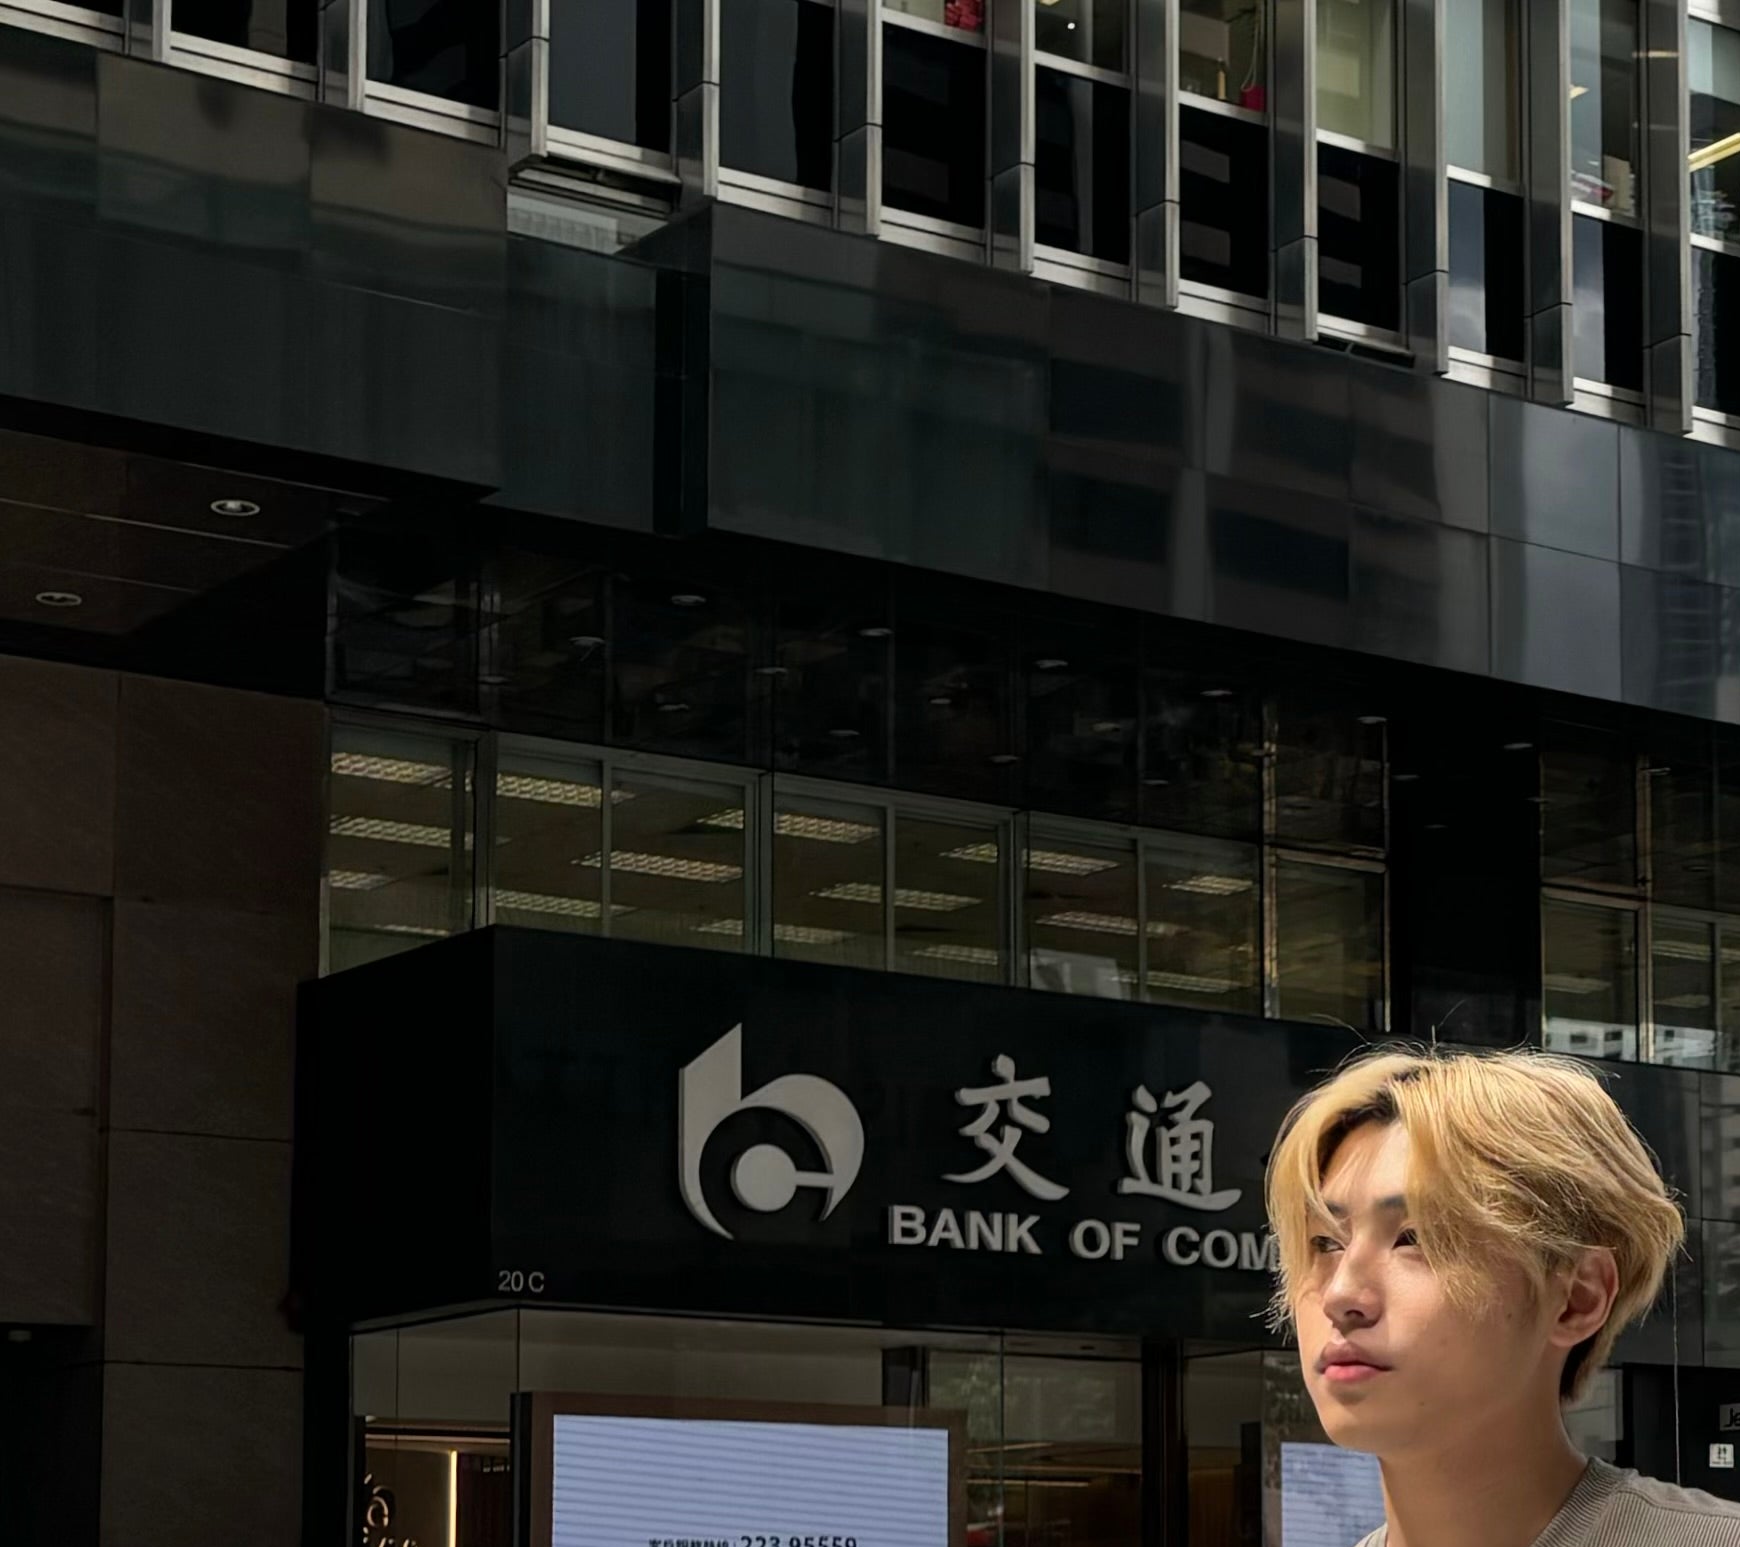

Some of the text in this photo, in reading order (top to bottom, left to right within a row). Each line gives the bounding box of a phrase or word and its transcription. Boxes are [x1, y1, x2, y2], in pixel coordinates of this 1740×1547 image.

[942, 1053, 1242, 1211] 交通
[888, 1204, 1042, 1254] BANK
[1069, 1219, 1141, 1260] OF
